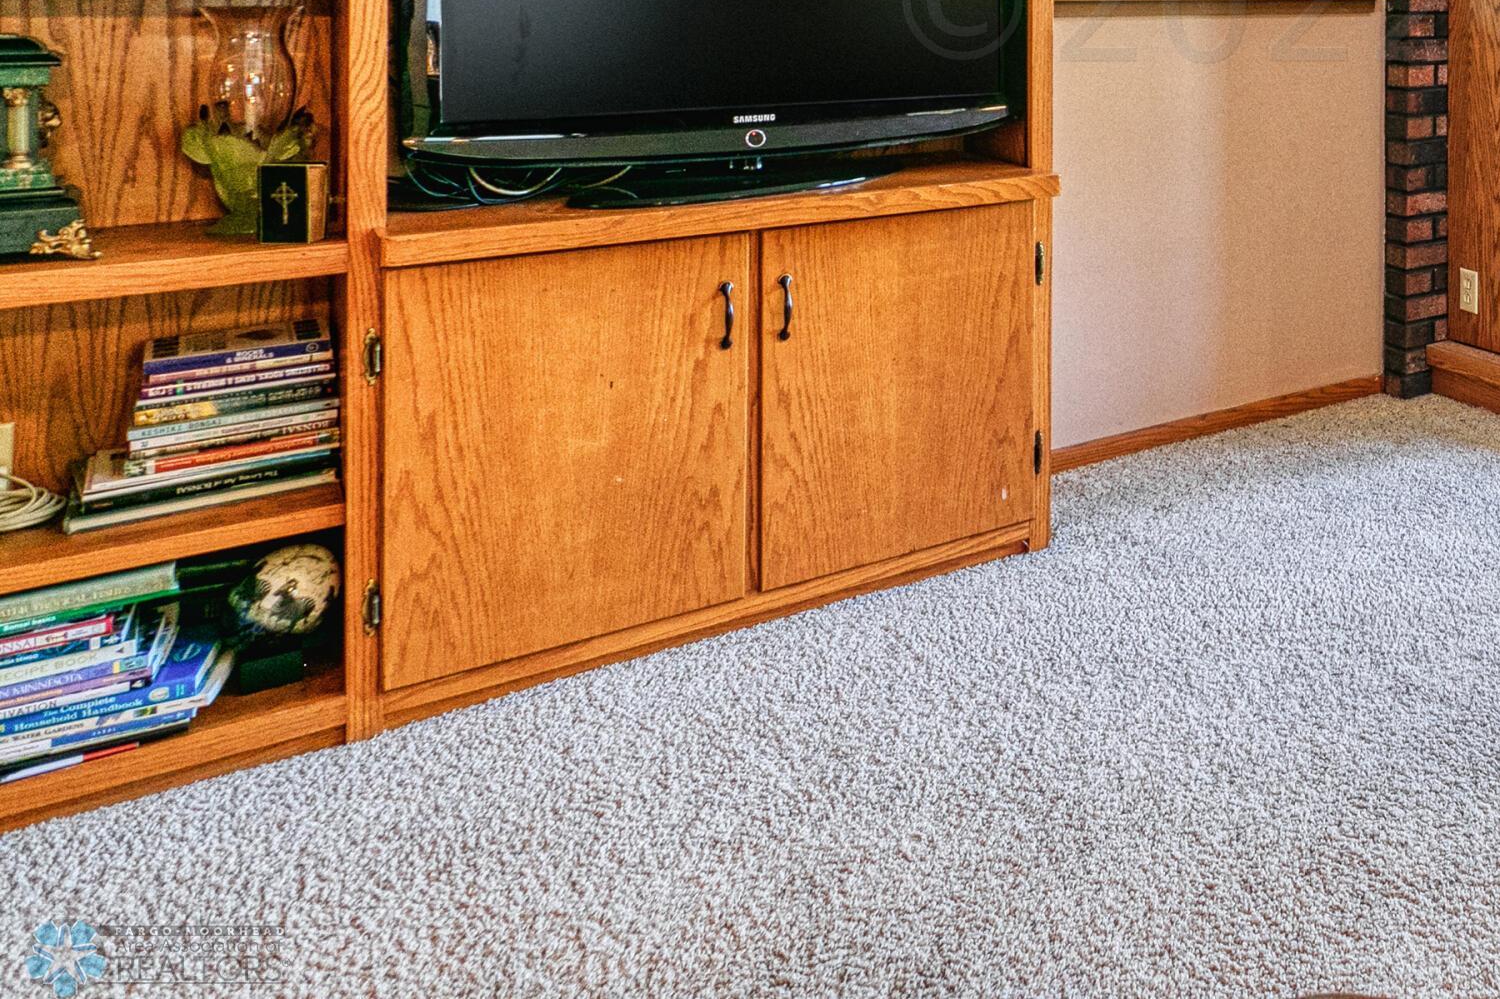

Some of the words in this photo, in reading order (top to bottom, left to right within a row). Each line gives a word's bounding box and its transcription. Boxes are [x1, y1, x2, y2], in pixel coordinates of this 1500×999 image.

[733, 113, 776, 124] SAMSUNG
[0, 636, 38, 655] NSAI
[60, 695, 117, 714] Complete
[14, 711, 78, 732] Household
[82, 699, 144, 719] Handbook
